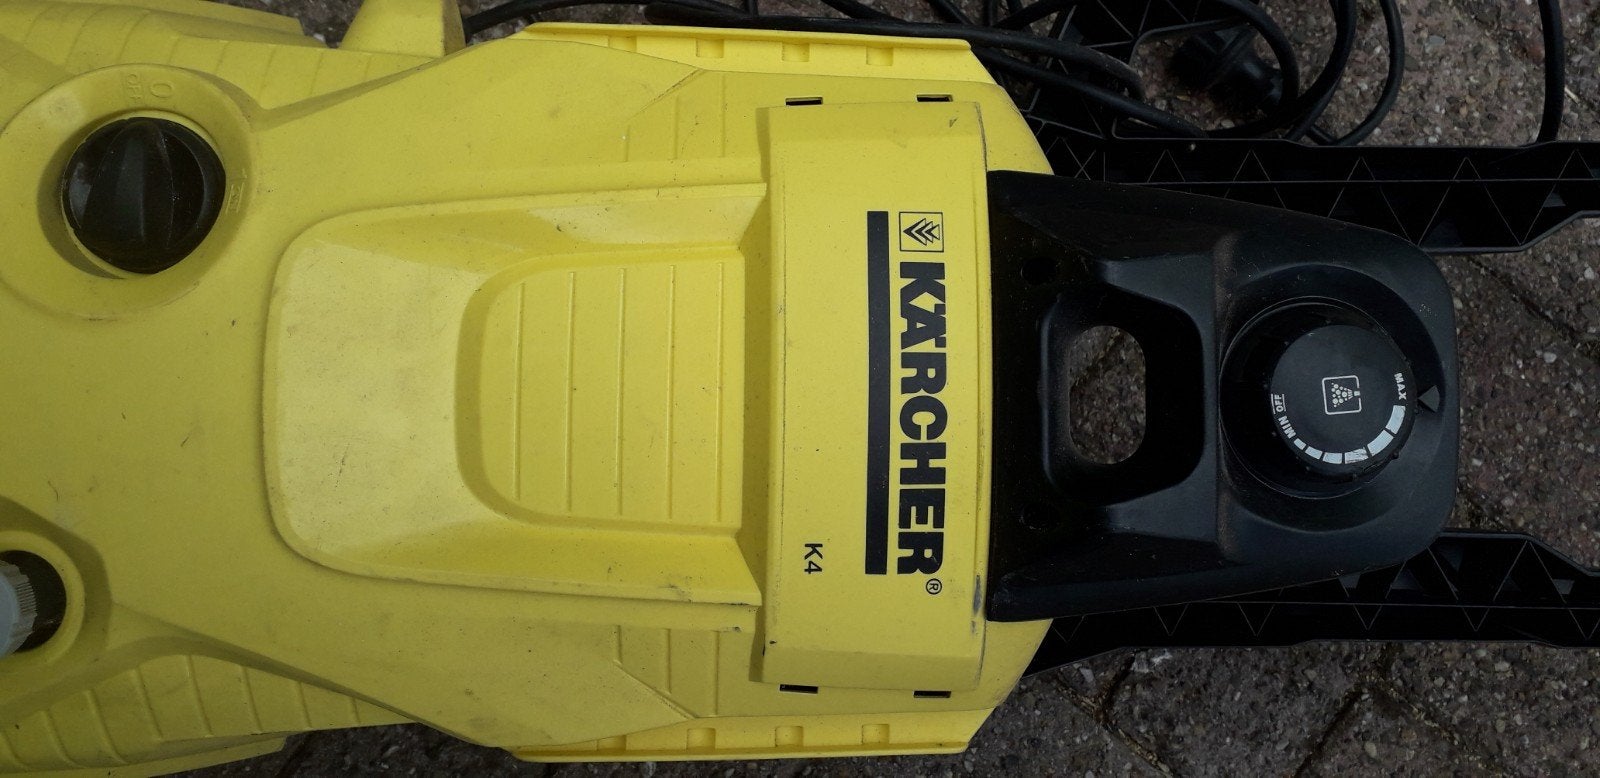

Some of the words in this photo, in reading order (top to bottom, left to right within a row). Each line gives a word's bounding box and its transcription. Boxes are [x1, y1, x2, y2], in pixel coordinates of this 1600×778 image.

[1394, 372, 1407, 400] MAX
[1274, 393, 1284, 413] OFF
[1277, 415, 1297, 439] MIN
